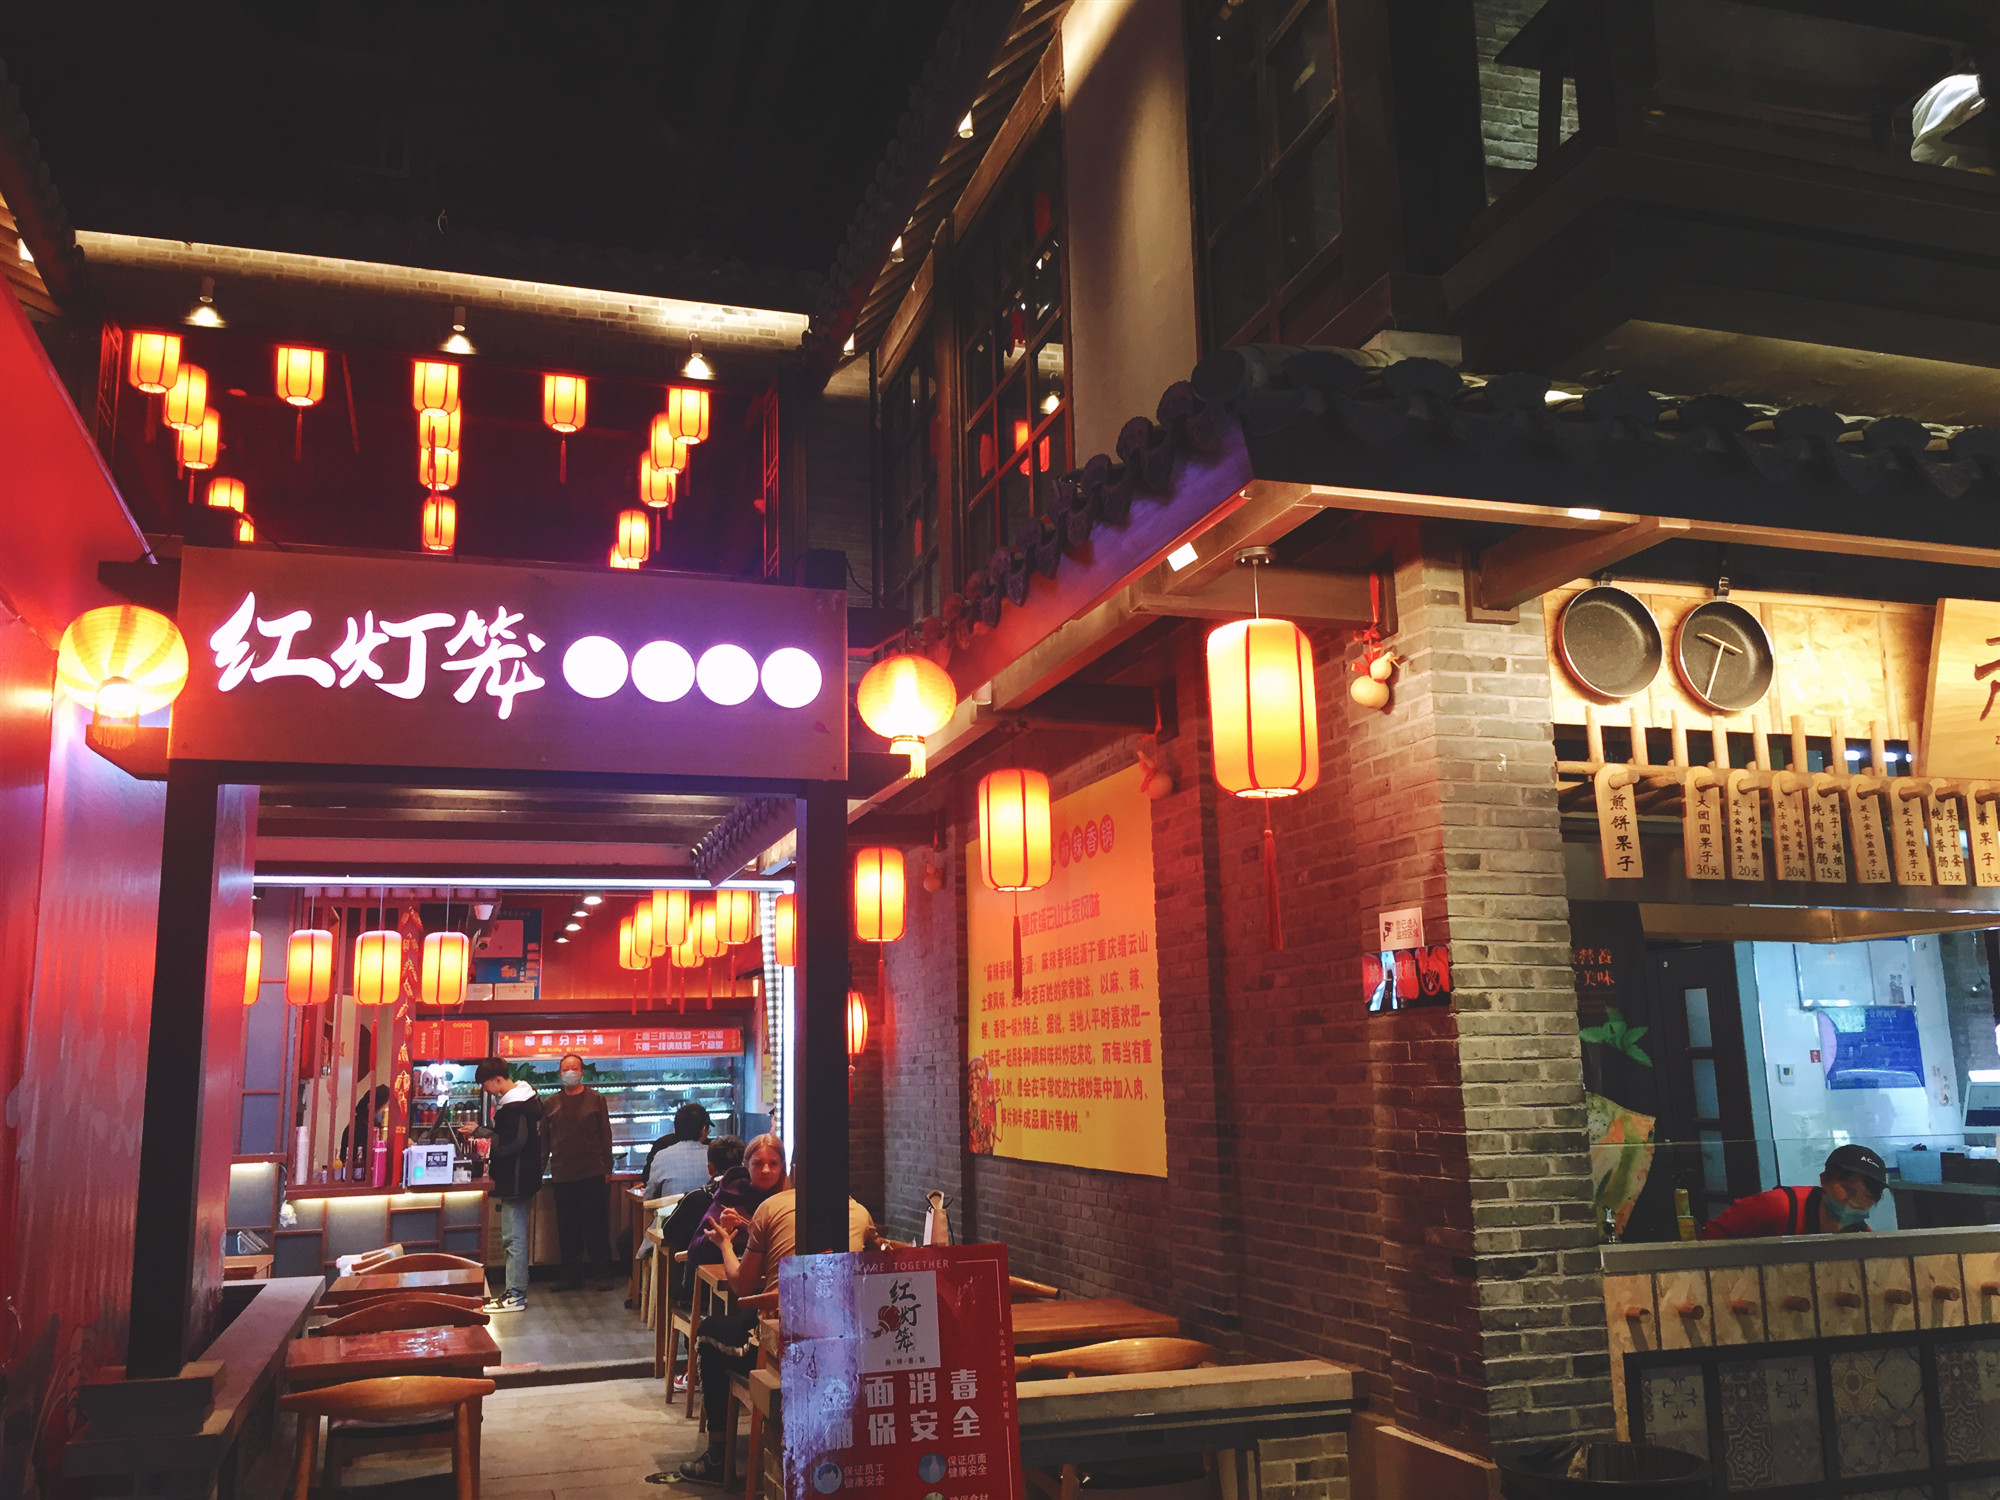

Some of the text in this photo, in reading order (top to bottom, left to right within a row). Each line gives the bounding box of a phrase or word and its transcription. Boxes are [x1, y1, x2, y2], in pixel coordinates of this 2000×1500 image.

[209, 592, 546, 720] 红灯笼
[1610, 794, 1635, 872] 煎饼果子
[1811, 803, 1829, 865] 纯肉香肠
[1931, 807, 1949, 869] 纯肉香肠
[1977, 810, 1995, 866] 素果子
[1696, 864, 1720, 876] 30元
[1738, 865, 1759, 877] 20元
[1786, 866, 1807, 877] 20元
[1821, 868, 1842, 879] 15元
[1866, 869, 1886, 880] 15元
[1906, 871, 1927, 882] 15元
[1943, 871, 1962, 882] 13元
[893, 1259, 949, 1271] TOGETHER
[888, 1279, 921, 1354] 红灯笼
[947, 1453, 987, 1467] 保证店面
[843, 1463, 885, 1476] 保证员工
